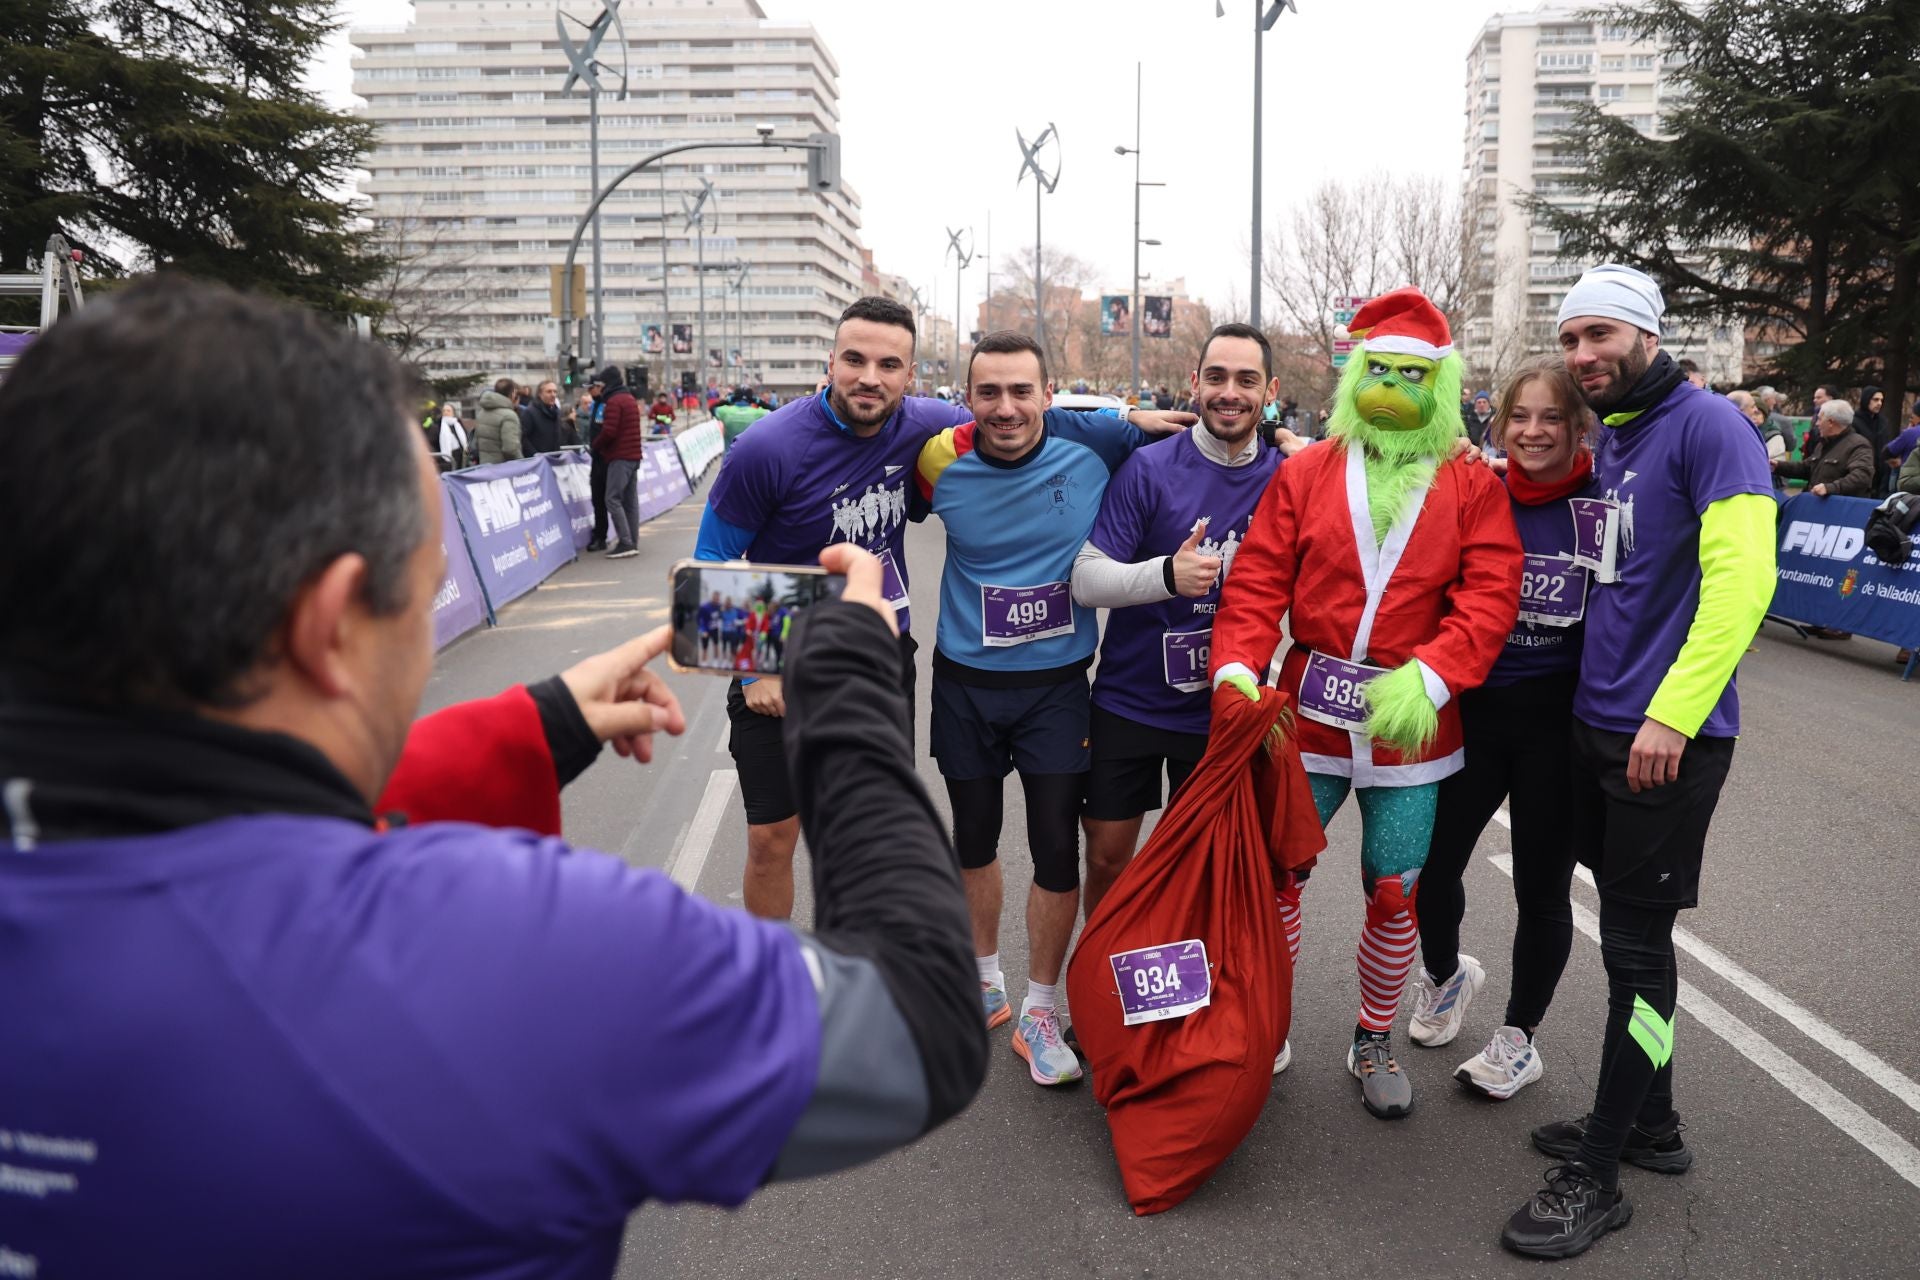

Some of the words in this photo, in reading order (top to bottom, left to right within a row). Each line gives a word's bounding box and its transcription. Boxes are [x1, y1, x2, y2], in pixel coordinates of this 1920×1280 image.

[1594, 518, 1604, 547] 8
[1781, 520, 1865, 562] FMD
[1520, 571, 1565, 602] 622
[1861, 581, 1875, 596] de
[1006, 599, 1048, 626] 499
[1193, 603, 1217, 614] PUCEL
[1506, 632, 1533, 647] UCELA
[1323, 675, 1366, 709] 935
[1134, 963, 1181, 996] 934
